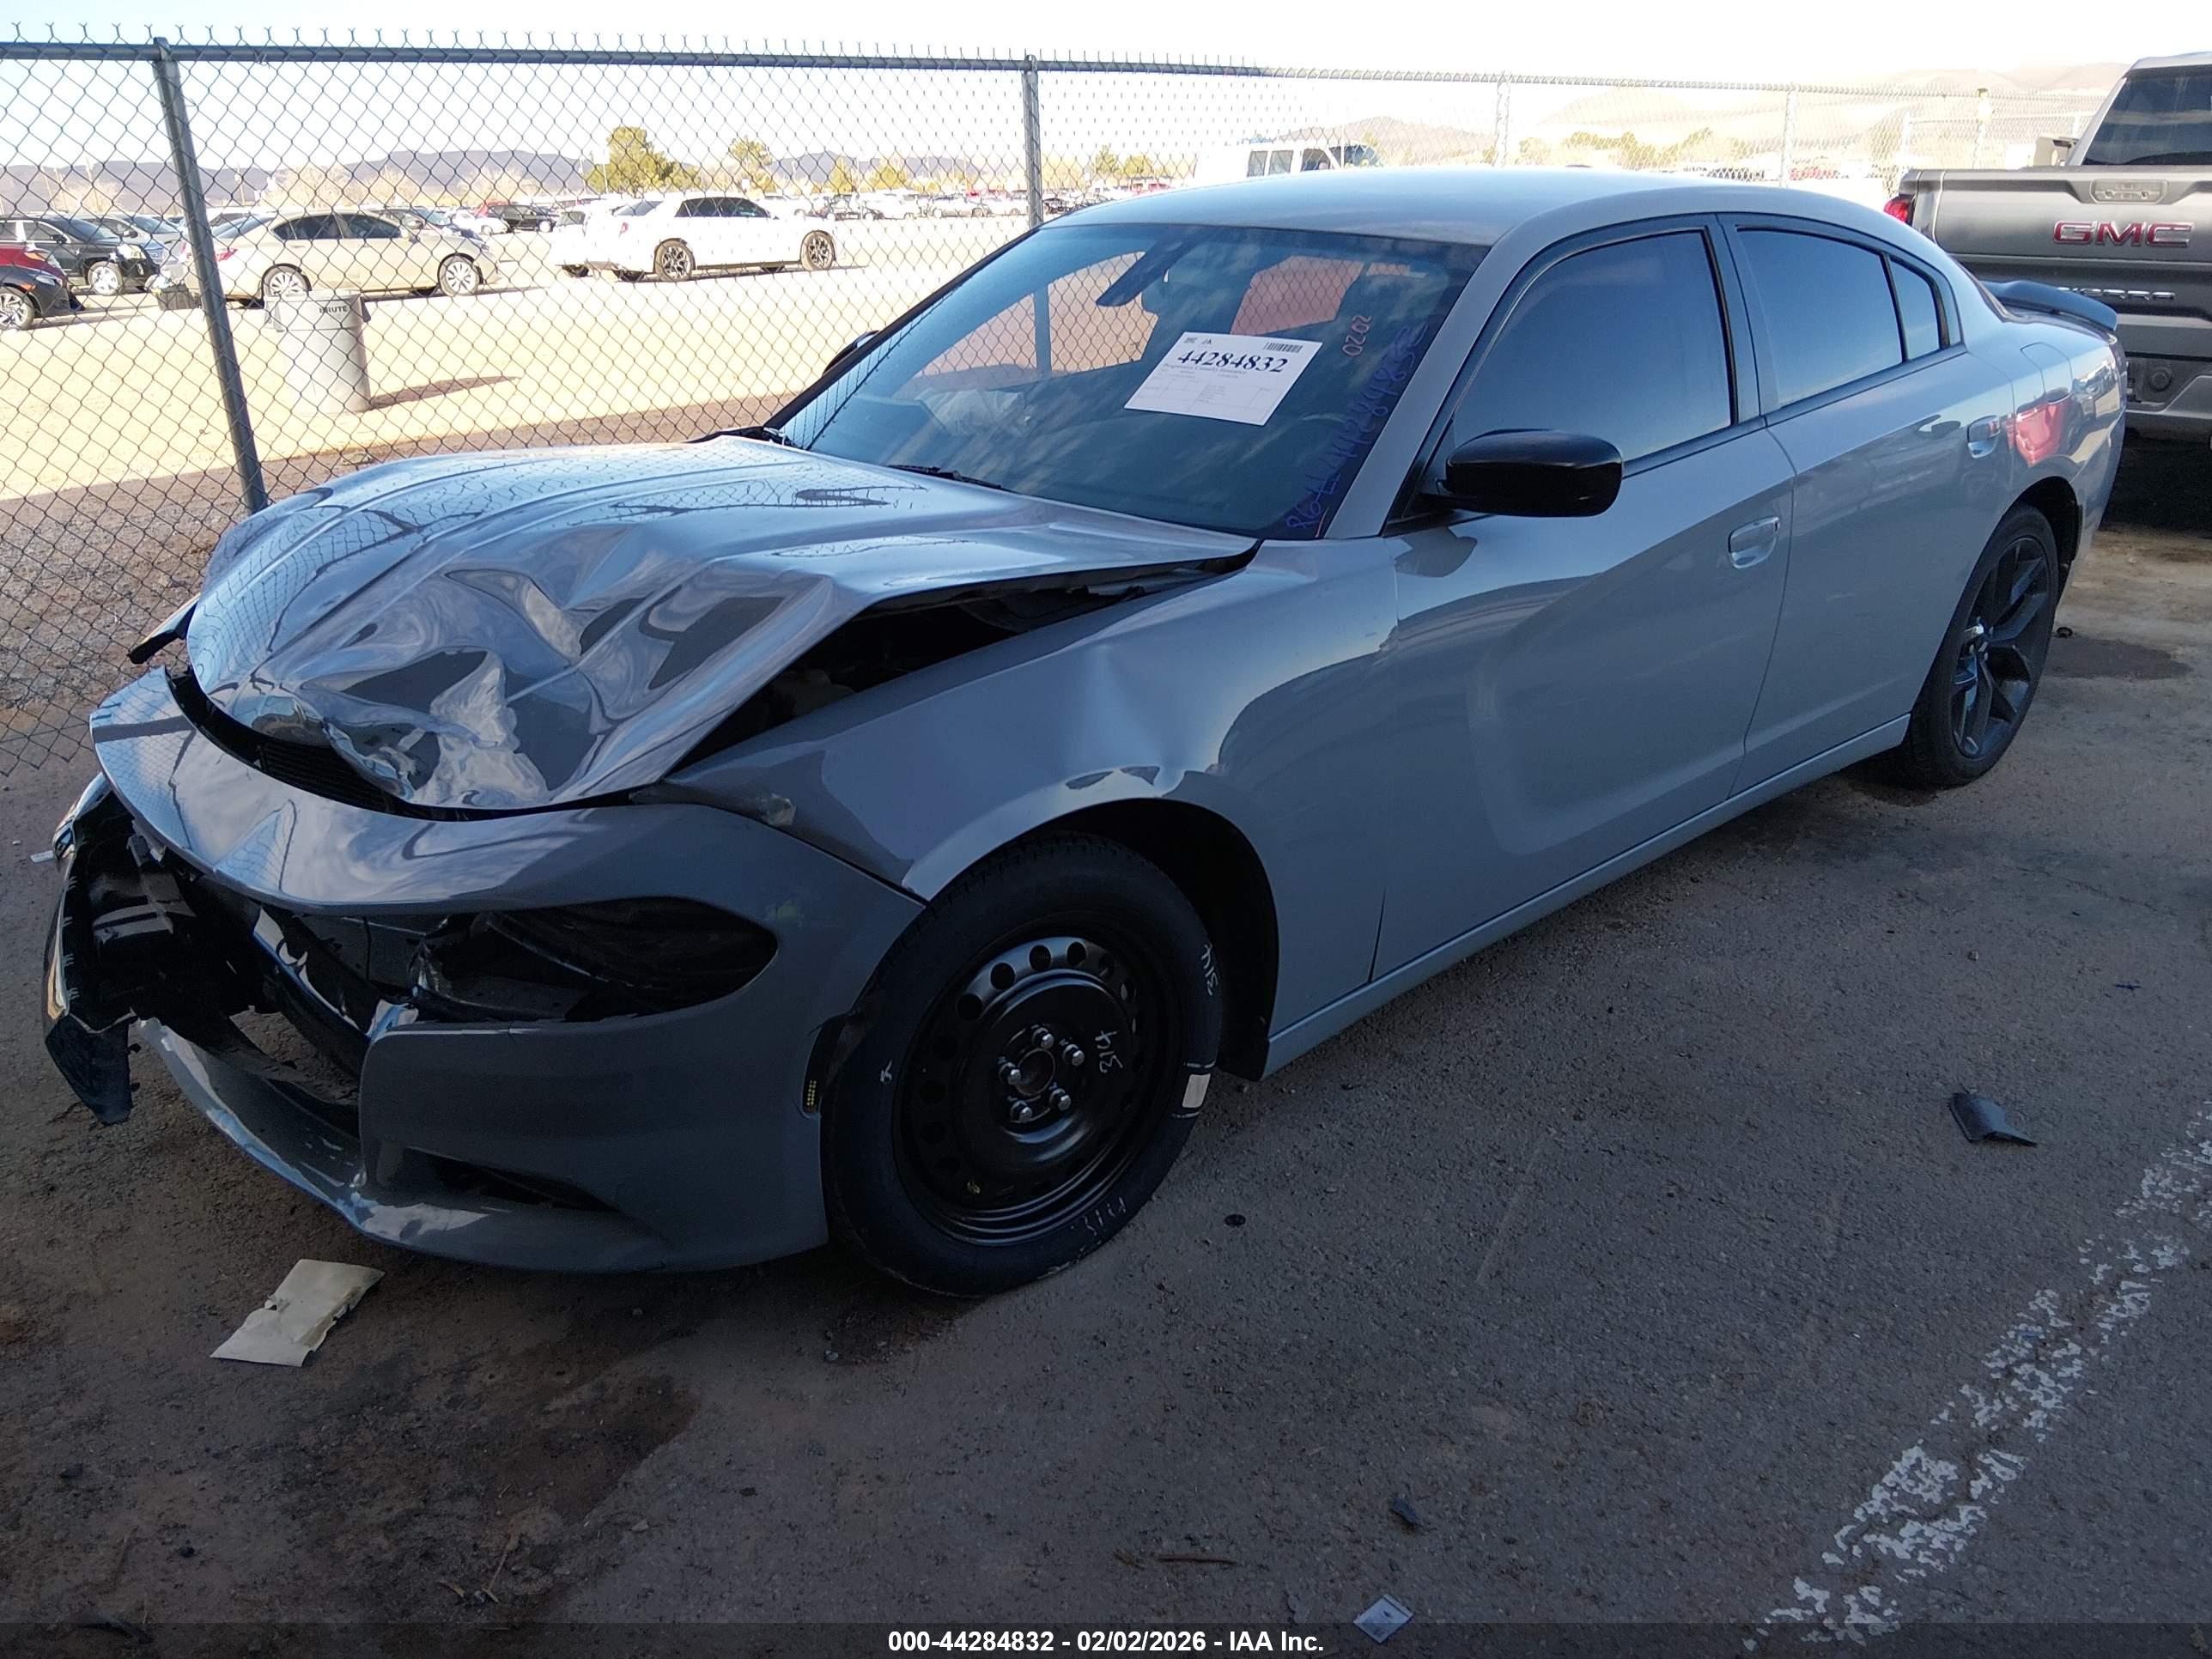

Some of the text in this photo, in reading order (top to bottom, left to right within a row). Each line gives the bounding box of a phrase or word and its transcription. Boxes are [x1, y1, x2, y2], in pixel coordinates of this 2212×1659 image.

[2053, 221, 2193, 247] GMC
[1342, 314, 1372, 357] 2020
[1177, 349, 1288, 374] 44284832
[1095, 1029, 1123, 1074] 314
